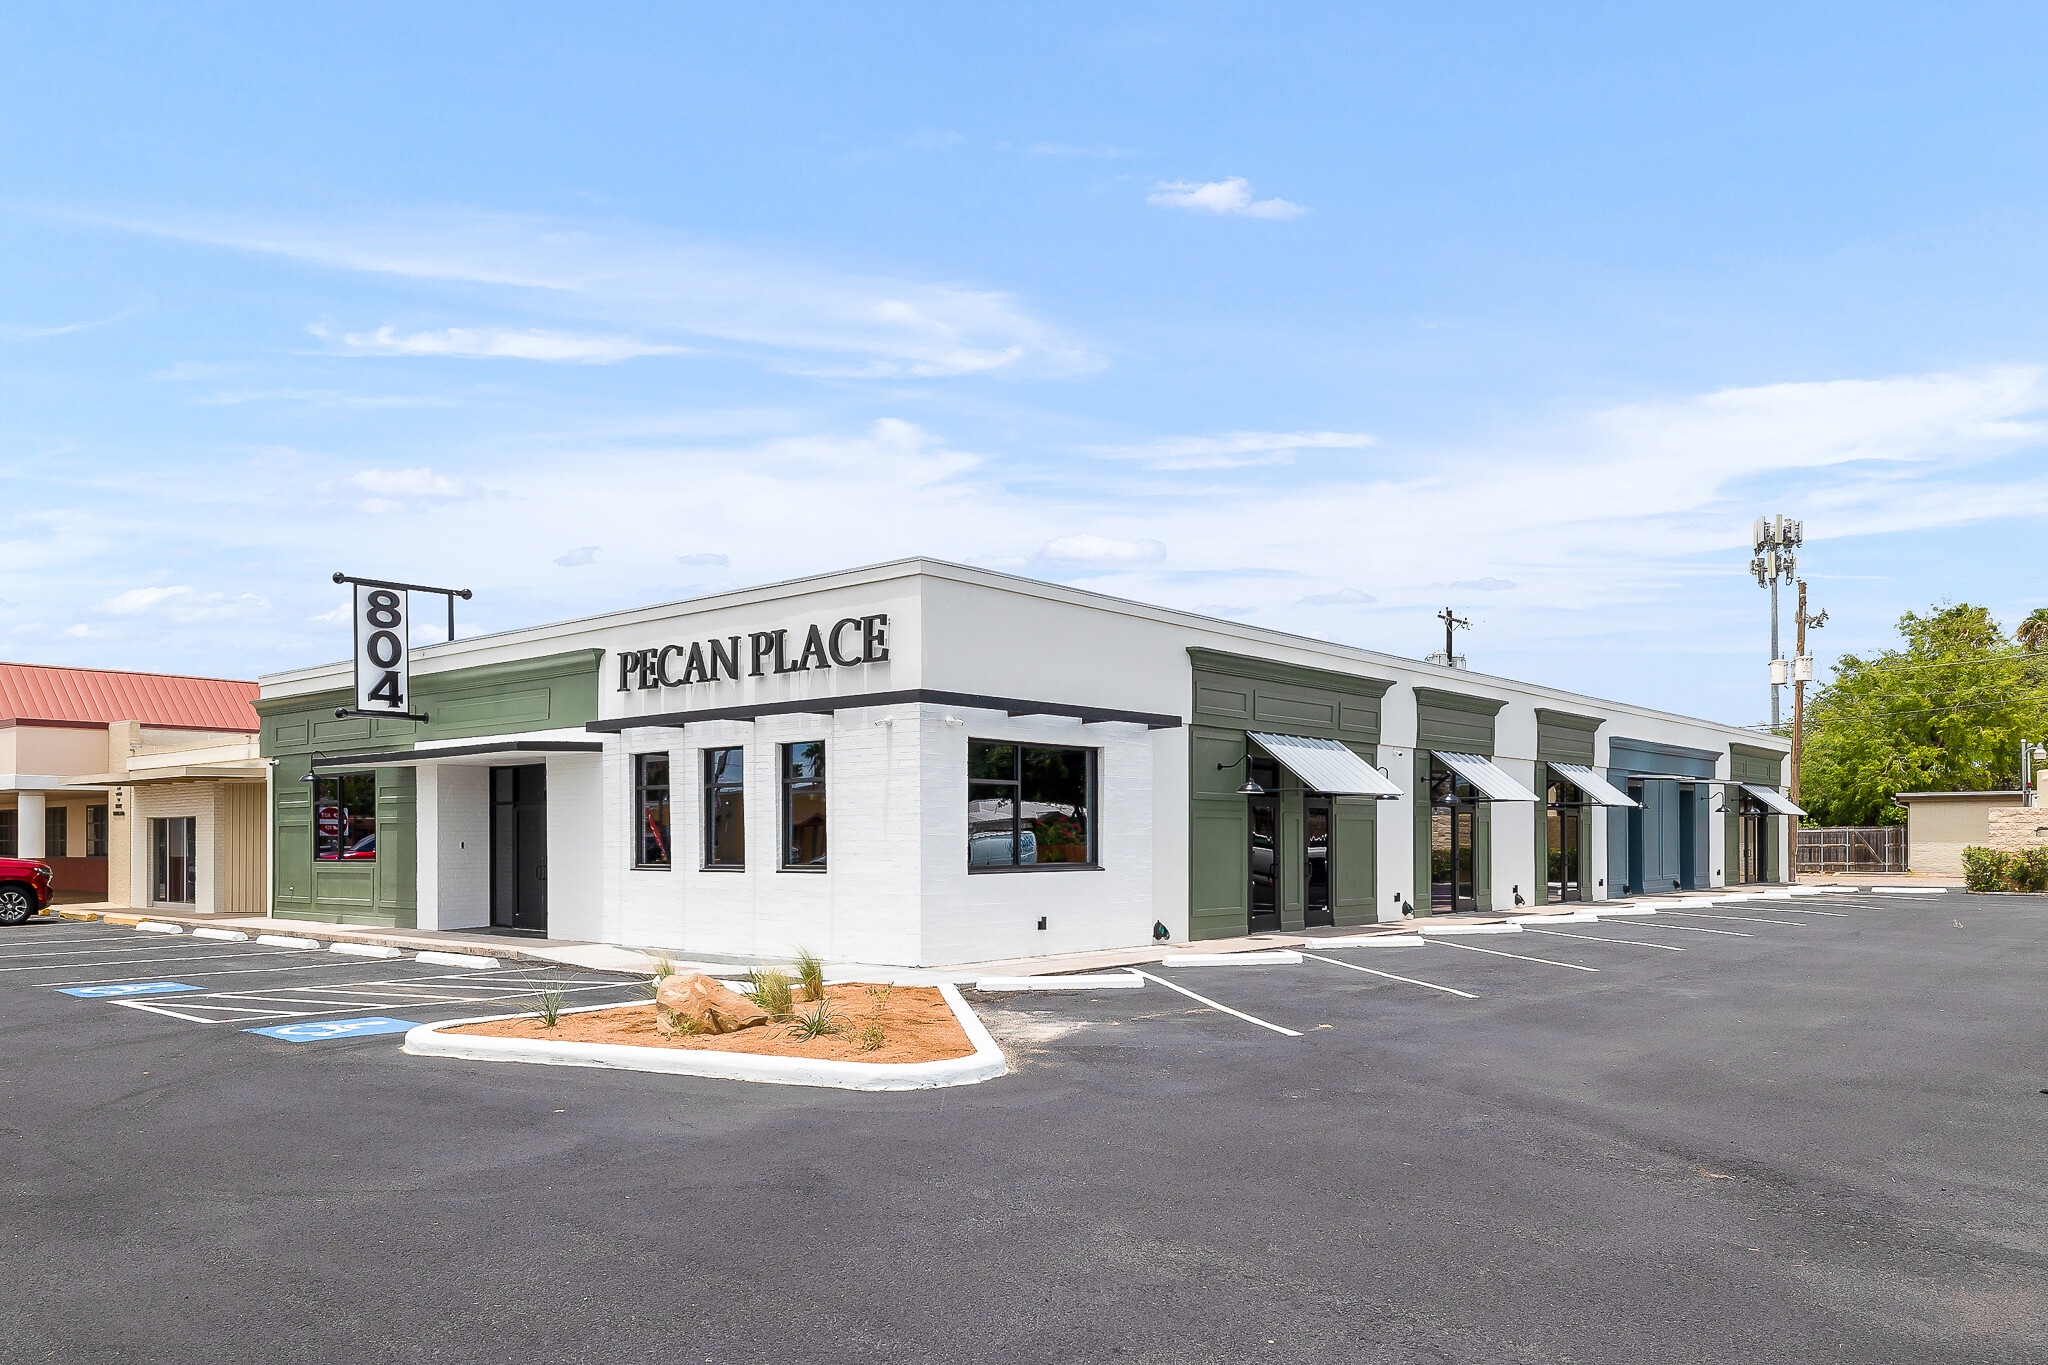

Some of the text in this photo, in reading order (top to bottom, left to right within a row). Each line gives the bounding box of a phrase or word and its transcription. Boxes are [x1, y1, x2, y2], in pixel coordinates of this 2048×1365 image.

[366, 589, 403, 708] 804
[616, 613, 889, 692] PECAN PLACE
